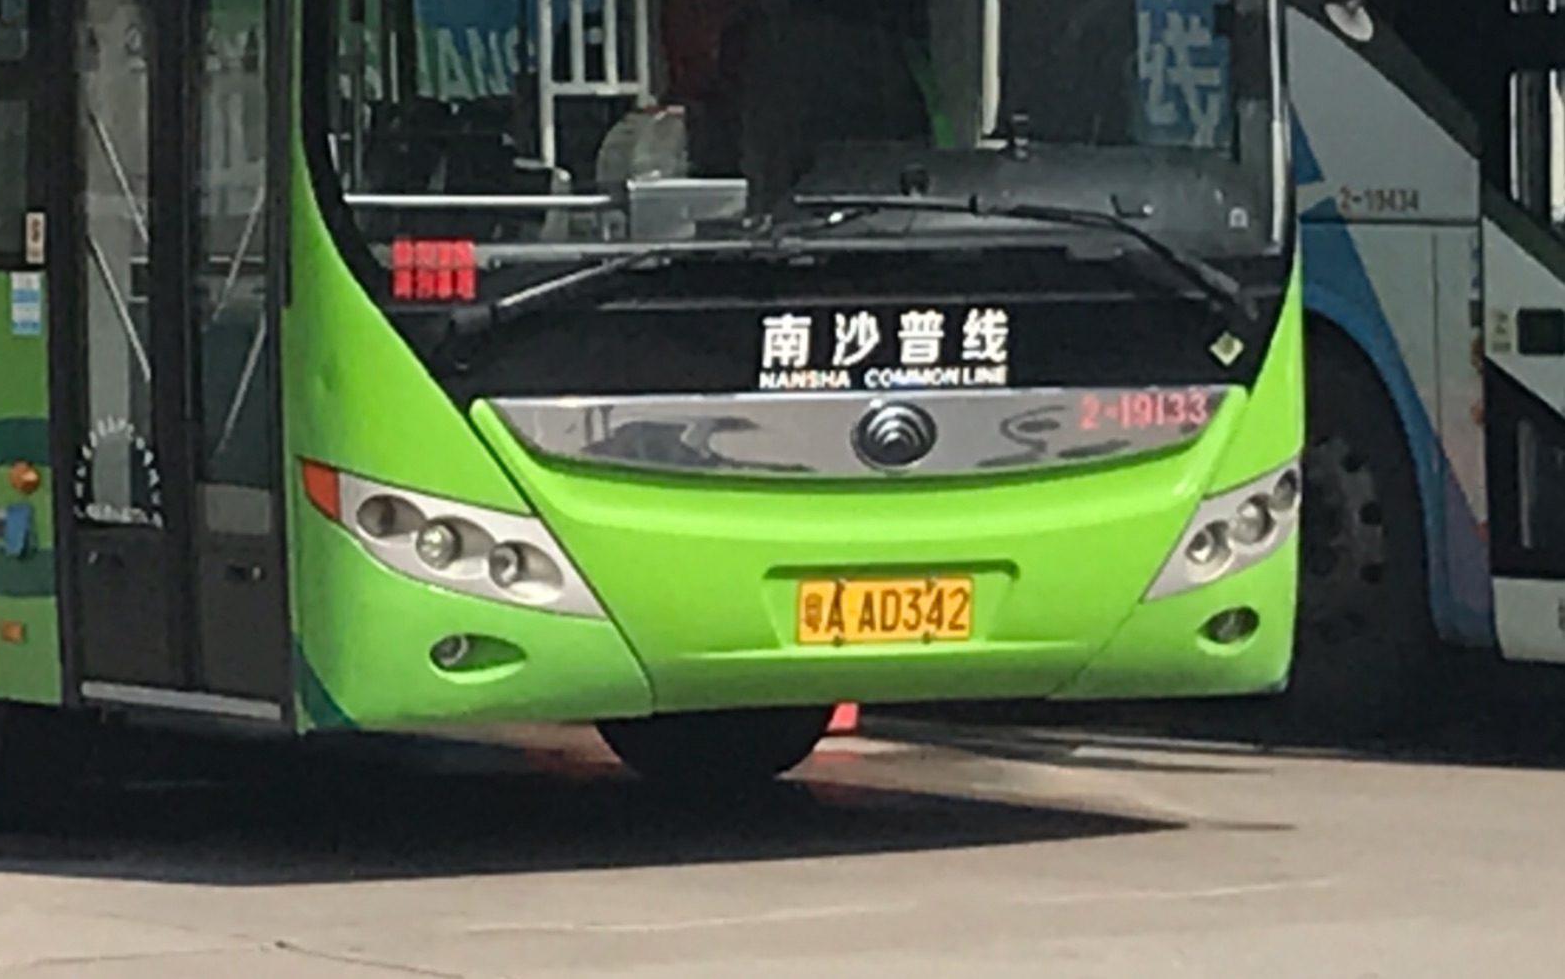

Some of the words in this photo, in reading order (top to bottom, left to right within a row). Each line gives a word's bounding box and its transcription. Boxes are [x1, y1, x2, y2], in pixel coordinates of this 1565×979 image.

[761, 308, 1010, 369] 南沙普线
[759, 369, 851, 389] NANSHA
[863, 368, 960, 388] COMMON
[962, 363, 1008, 386] LINE
[1080, 392, 1209, 429] 2-19133
